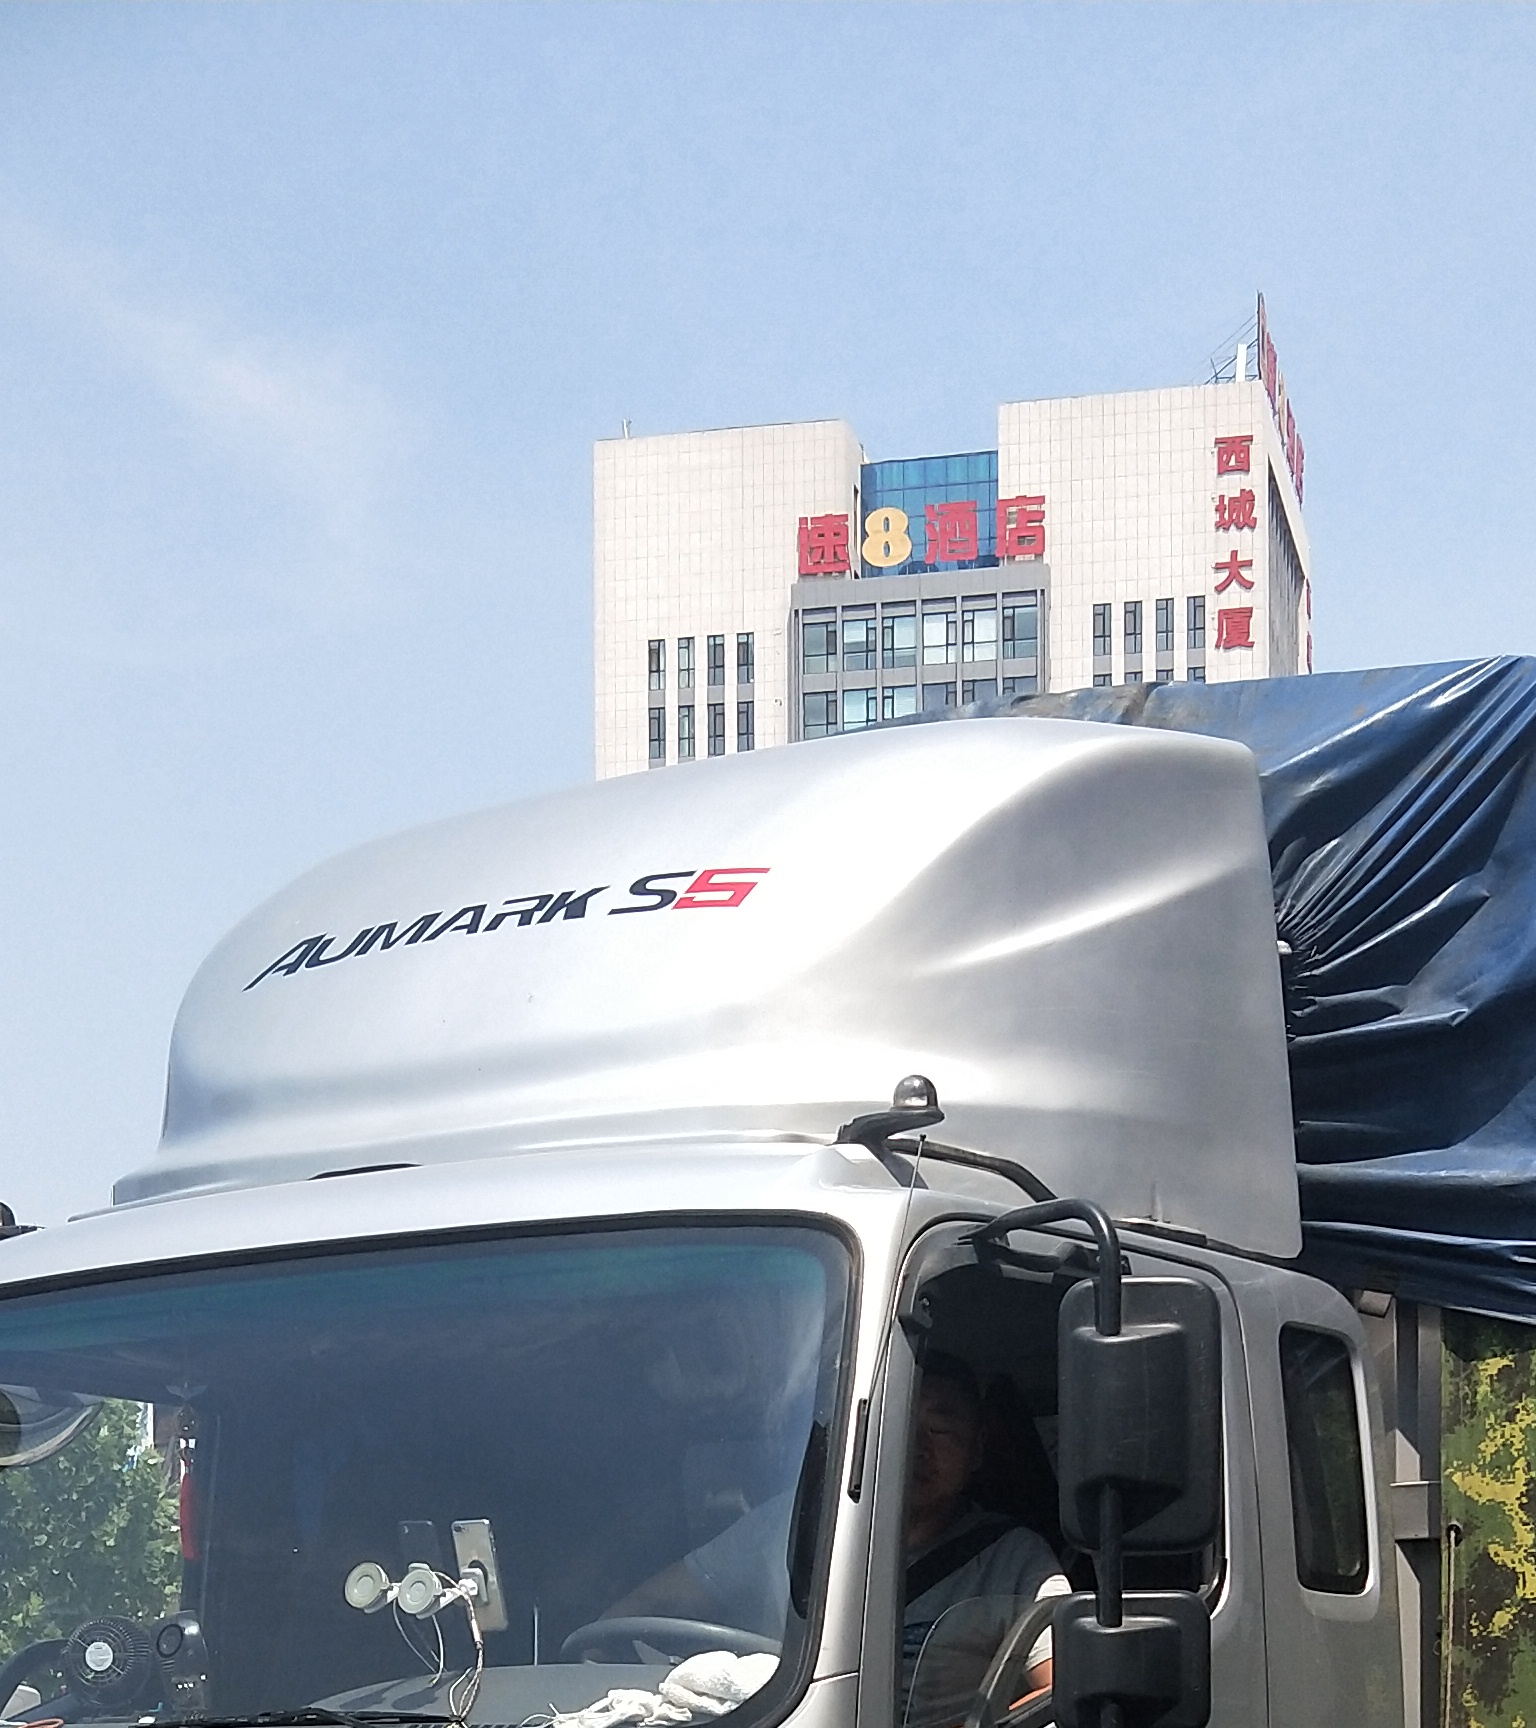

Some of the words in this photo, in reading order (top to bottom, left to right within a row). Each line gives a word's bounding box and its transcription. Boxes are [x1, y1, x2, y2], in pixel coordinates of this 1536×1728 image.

[797, 495, 1046, 575] 速8酒店
[1214, 435, 1257, 651] 西城大厦
[241, 885, 611, 992] AUMARK
[607, 867, 772, 916] S5
